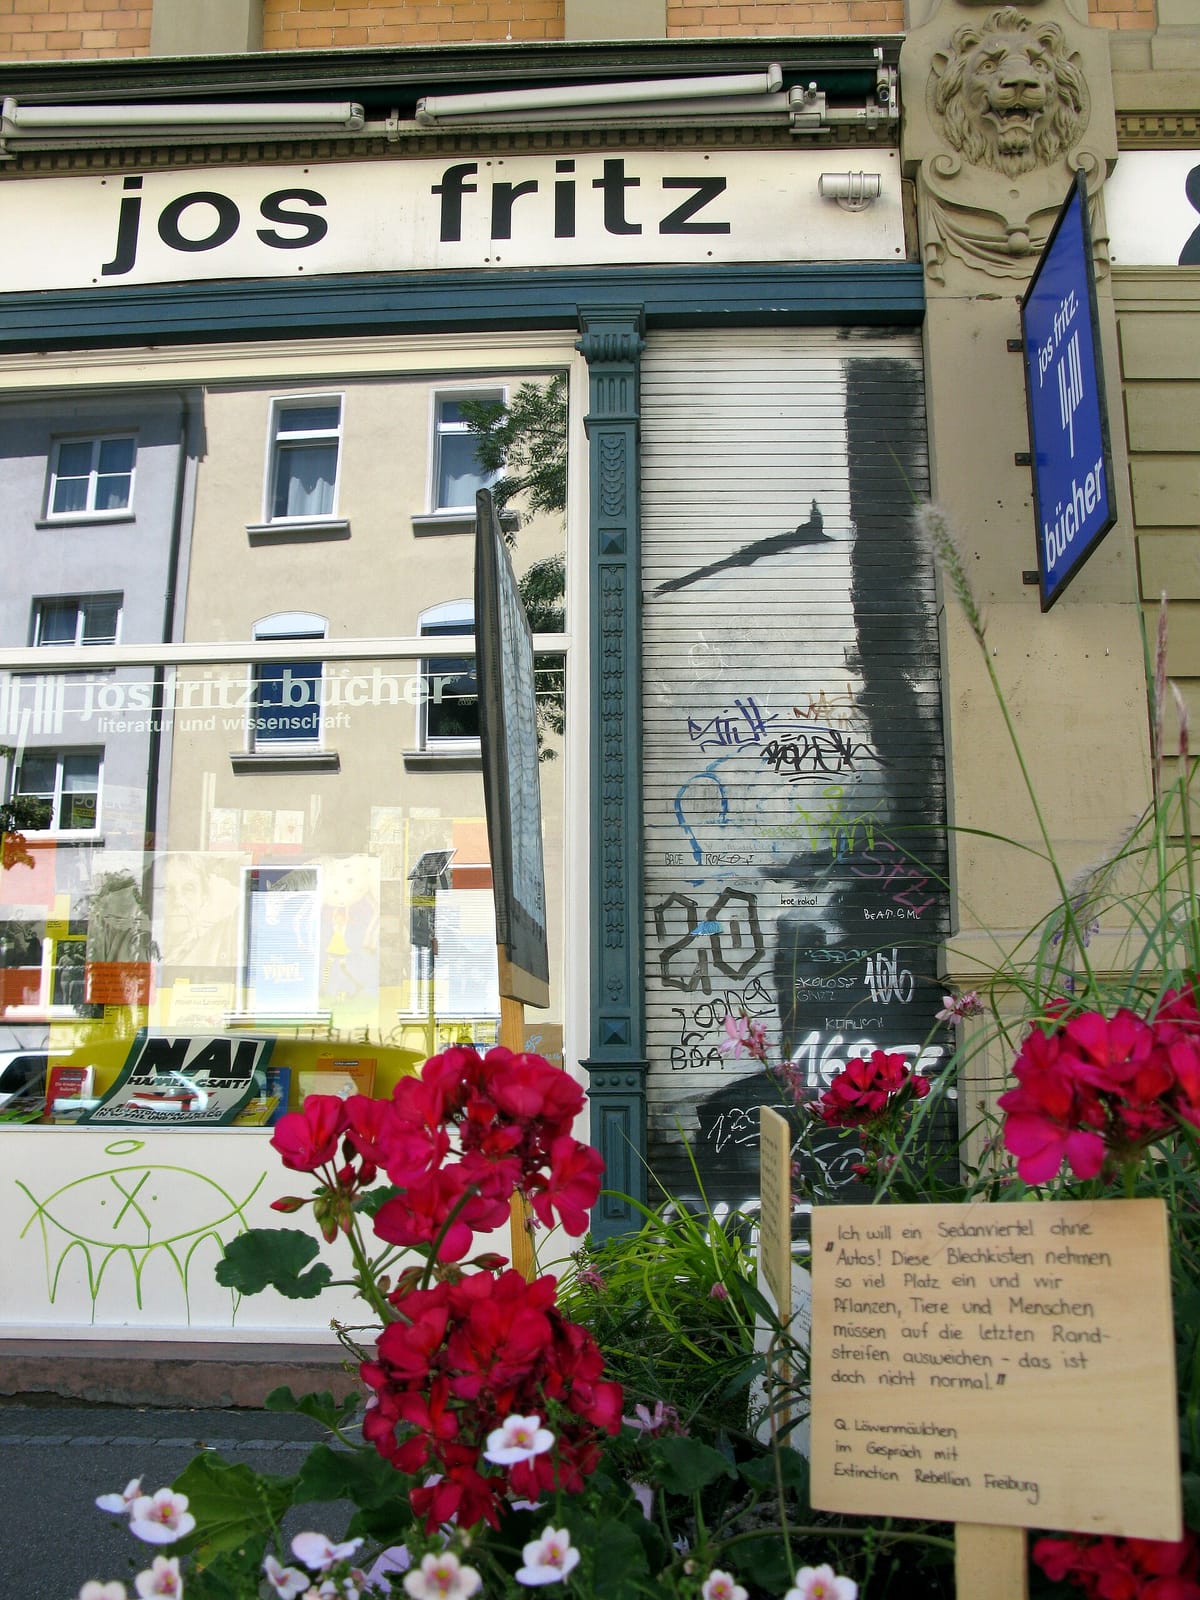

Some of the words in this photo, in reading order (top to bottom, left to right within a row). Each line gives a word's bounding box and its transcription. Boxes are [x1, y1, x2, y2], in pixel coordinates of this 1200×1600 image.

[102, 176, 328, 276] jos
[431, 158, 731, 242] fritz
[1037, 336, 1053, 388] jos
[1045, 457, 1102, 573] bücher
[80, 675, 152, 722] jos
[282, 667, 451, 708] bücher
[97, 717, 173, 733] literatur
[180, 715, 216, 732] und
[223, 712, 351, 731] wissenschaft
[132, 1038, 258, 1079] NAI
[838, 1225, 860, 1240] Ich
[867, 1225, 891, 1240] will
[902, 1225, 922, 1239] ein
[937, 1219, 1034, 1238] Sedanviertel
[1050, 1218, 1093, 1236] ohne
[892, 1250, 932, 1266] Diese
[947, 1246, 1034, 1265] Blechkisten
[1045, 1246, 1112, 1266] nehmen
[834, 1277, 851, 1288] so
[862, 1273, 885, 1288] viel
[904, 1273, 941, 1288] Platz
[951, 1274, 976, 1288] ein
[989, 1272, 1020, 1288] und
[1034, 1273, 1063, 1288] wir
[833, 1298, 902, 1319] Pflanzen,
[910, 1297, 950, 1314] Tiere
[962, 1298, 993, 1315] und
[1009, 1296, 1095, 1318] Menschen
[833, 1322, 886, 1339] müssen
[901, 1321, 928, 1338] auf
[939, 1324, 963, 1340] die
[979, 1323, 1035, 1342] letzten
[831, 1344, 890, 1362] streifen
[903, 1350, 993, 1367] ausweichen
[1018, 1352, 1051, 1369] das
[1063, 1351, 1089, 1369] ist
[831, 1369, 866, 1384] doch
[879, 1370, 915, 1386] nicht
[835, 1440, 852, 1452] im
[866, 1441, 922, 1461] Gespräch
[934, 1445, 959, 1461] mit
[833, 1463, 899, 1481] Extinction
[915, 1468, 971, 1488] Rebellion
[984, 1473, 1040, 1505] Freiburg
